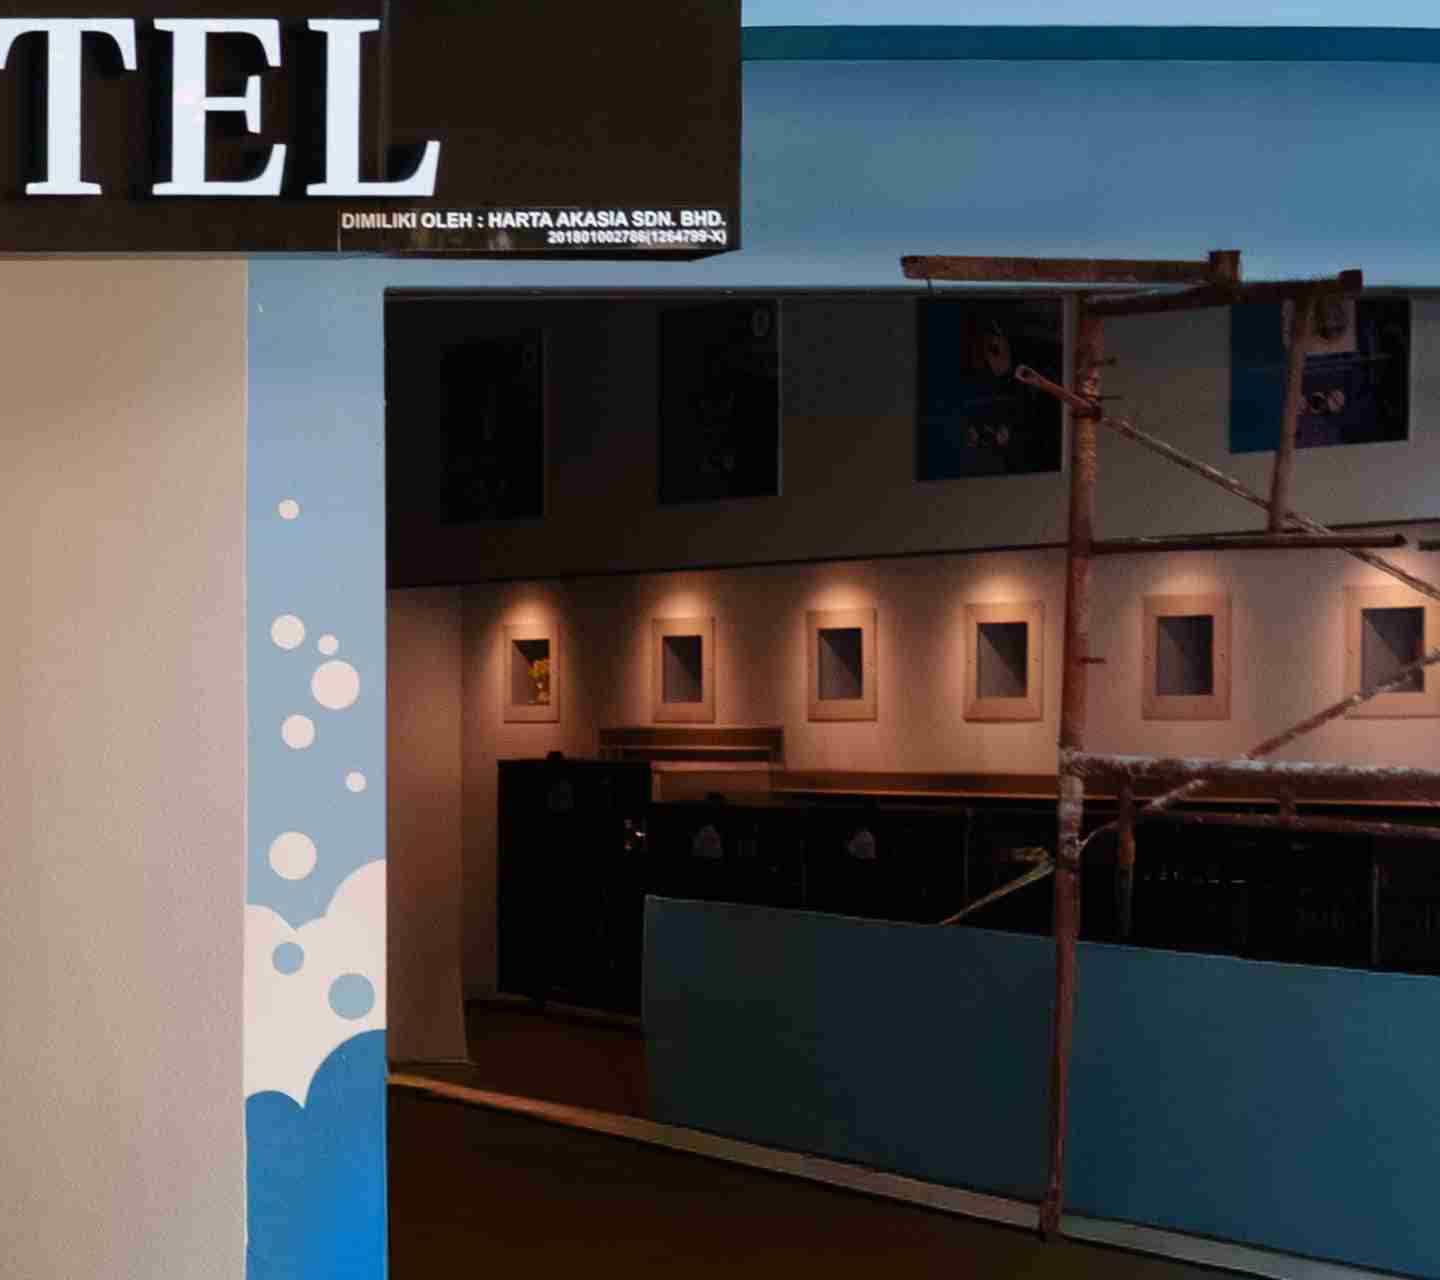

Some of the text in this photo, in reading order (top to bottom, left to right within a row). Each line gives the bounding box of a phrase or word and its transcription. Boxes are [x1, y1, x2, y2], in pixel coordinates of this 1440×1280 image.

[341, 211, 418, 229] DIMILIKI
[420, 211, 473, 229] OLEH
[488, 211, 554, 228] HARTA
[557, 210, 629, 228] AKASIA
[631, 210, 677, 228] SDN.
[680, 210, 727, 227] BHD.
